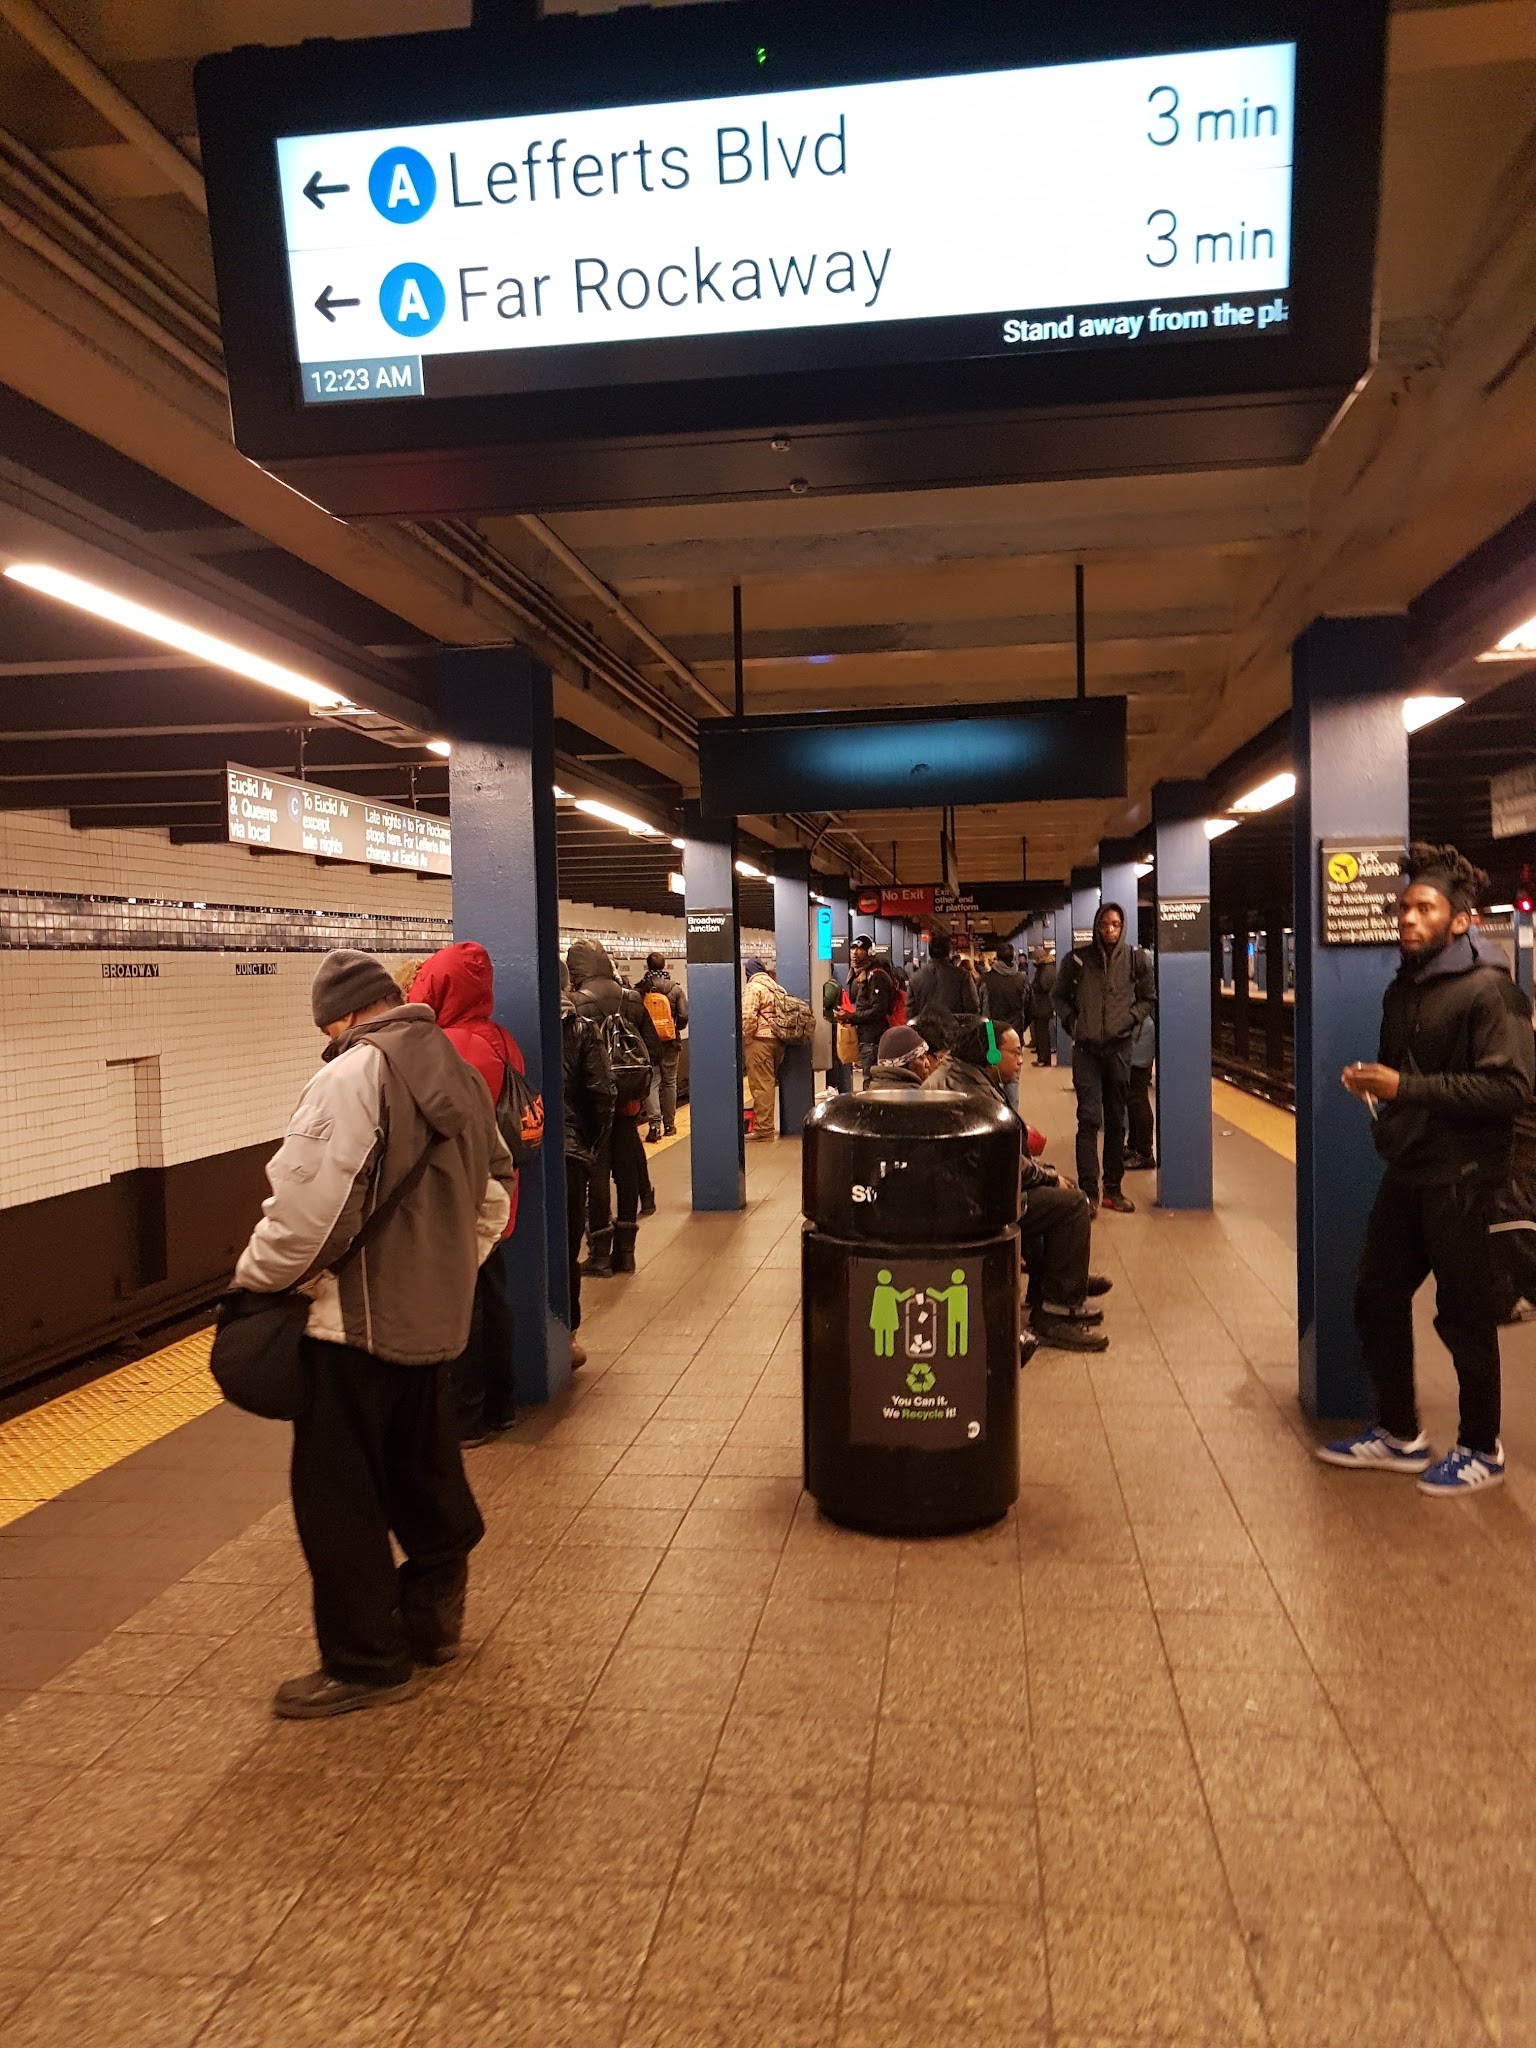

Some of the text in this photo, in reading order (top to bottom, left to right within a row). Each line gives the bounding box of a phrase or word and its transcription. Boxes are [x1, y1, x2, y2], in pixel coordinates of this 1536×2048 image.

[1147, 85, 1278, 146] 3 min
[386, 114, 848, 209] A Lefferts Blvd
[1146, 209, 1275, 268] 3 min
[396, 246, 893, 322] A Far Rockaway
[1003, 315, 1074, 343] Stand
[1079, 314, 1143, 340] away
[1149, 307, 1208, 332] from
[1212, 302, 1254, 327] the
[311, 363, 412, 394] 12:23 AM
[228, 773, 273, 801] Euclid Av
[230, 796, 278, 823] & Queens
[302, 791, 349, 817] To Euclid Av
[230, 819, 271, 843] via local
[302, 815, 330, 836] except
[365, 807, 380, 825] Late
[382, 812, 401, 831] nights
[426, 822, 451, 840] Rockawa
[319, 836, 343, 856] nights
[366, 827, 385, 846] stops
[1358, 862, 1400, 878] AIRPOR
[882, 889, 924, 901] No Exit
[934, 895, 973, 904] other end
[1342, 892, 1385, 905] Rockaway
[934, 904, 979, 912] of platform
[1159, 903, 1202, 914] Broadway
[1160, 912, 1196, 922] Junction
[1327, 904, 1370, 917] Rockaway
[688, 916, 725, 926] Broadway
[688, 924, 721, 933] Junction
[102, 963, 277, 978] BROADWAY JUNCTION
[891, 1395, 912, 1407] You
[913, 1395, 935, 1407] Can
[882, 1407, 901, 1420] We
[901, 1408, 944, 1422] Recycle
